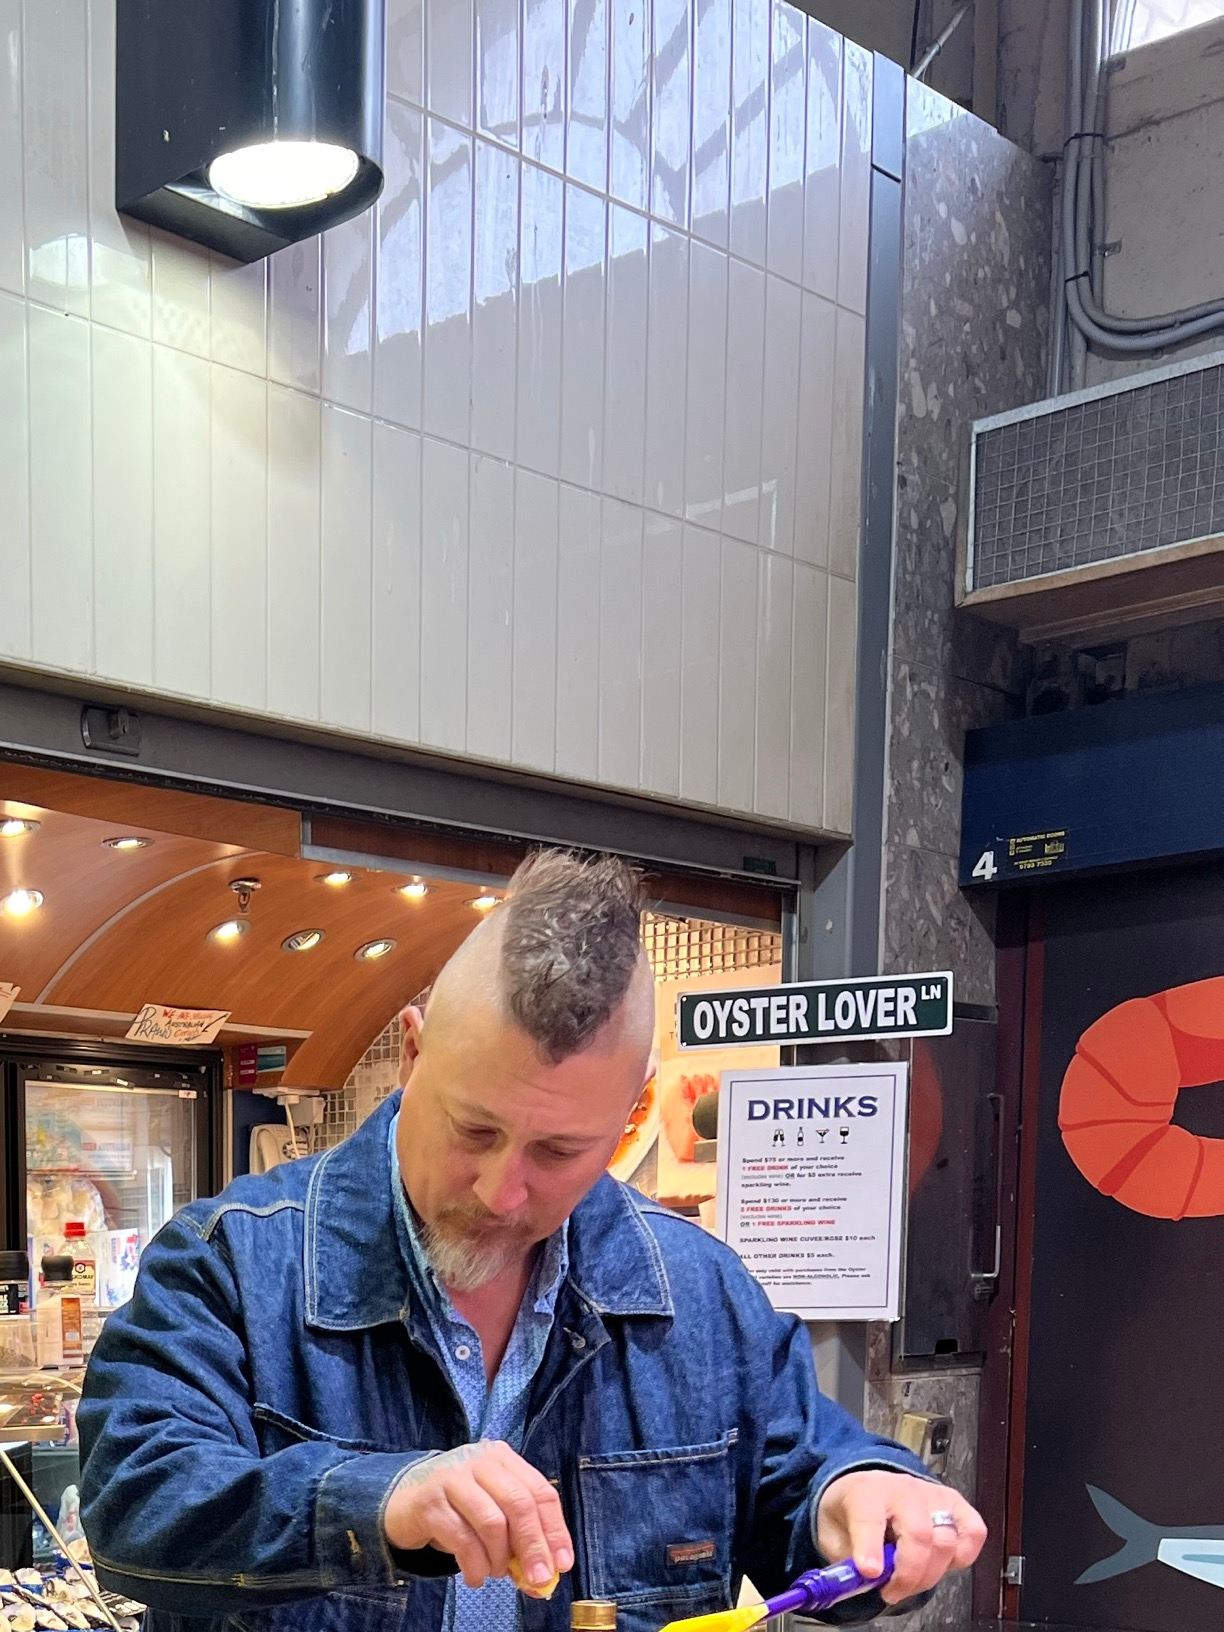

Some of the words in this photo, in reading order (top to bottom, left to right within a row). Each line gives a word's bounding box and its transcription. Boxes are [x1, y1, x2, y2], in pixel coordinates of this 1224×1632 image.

[971, 851, 997, 880] 4
[693, 993, 809, 1039] OYSTER
[817, 986, 918, 1031] LOVER
[921, 984, 942, 1001] LN
[747, 1096, 878, 1121] DRINKS
